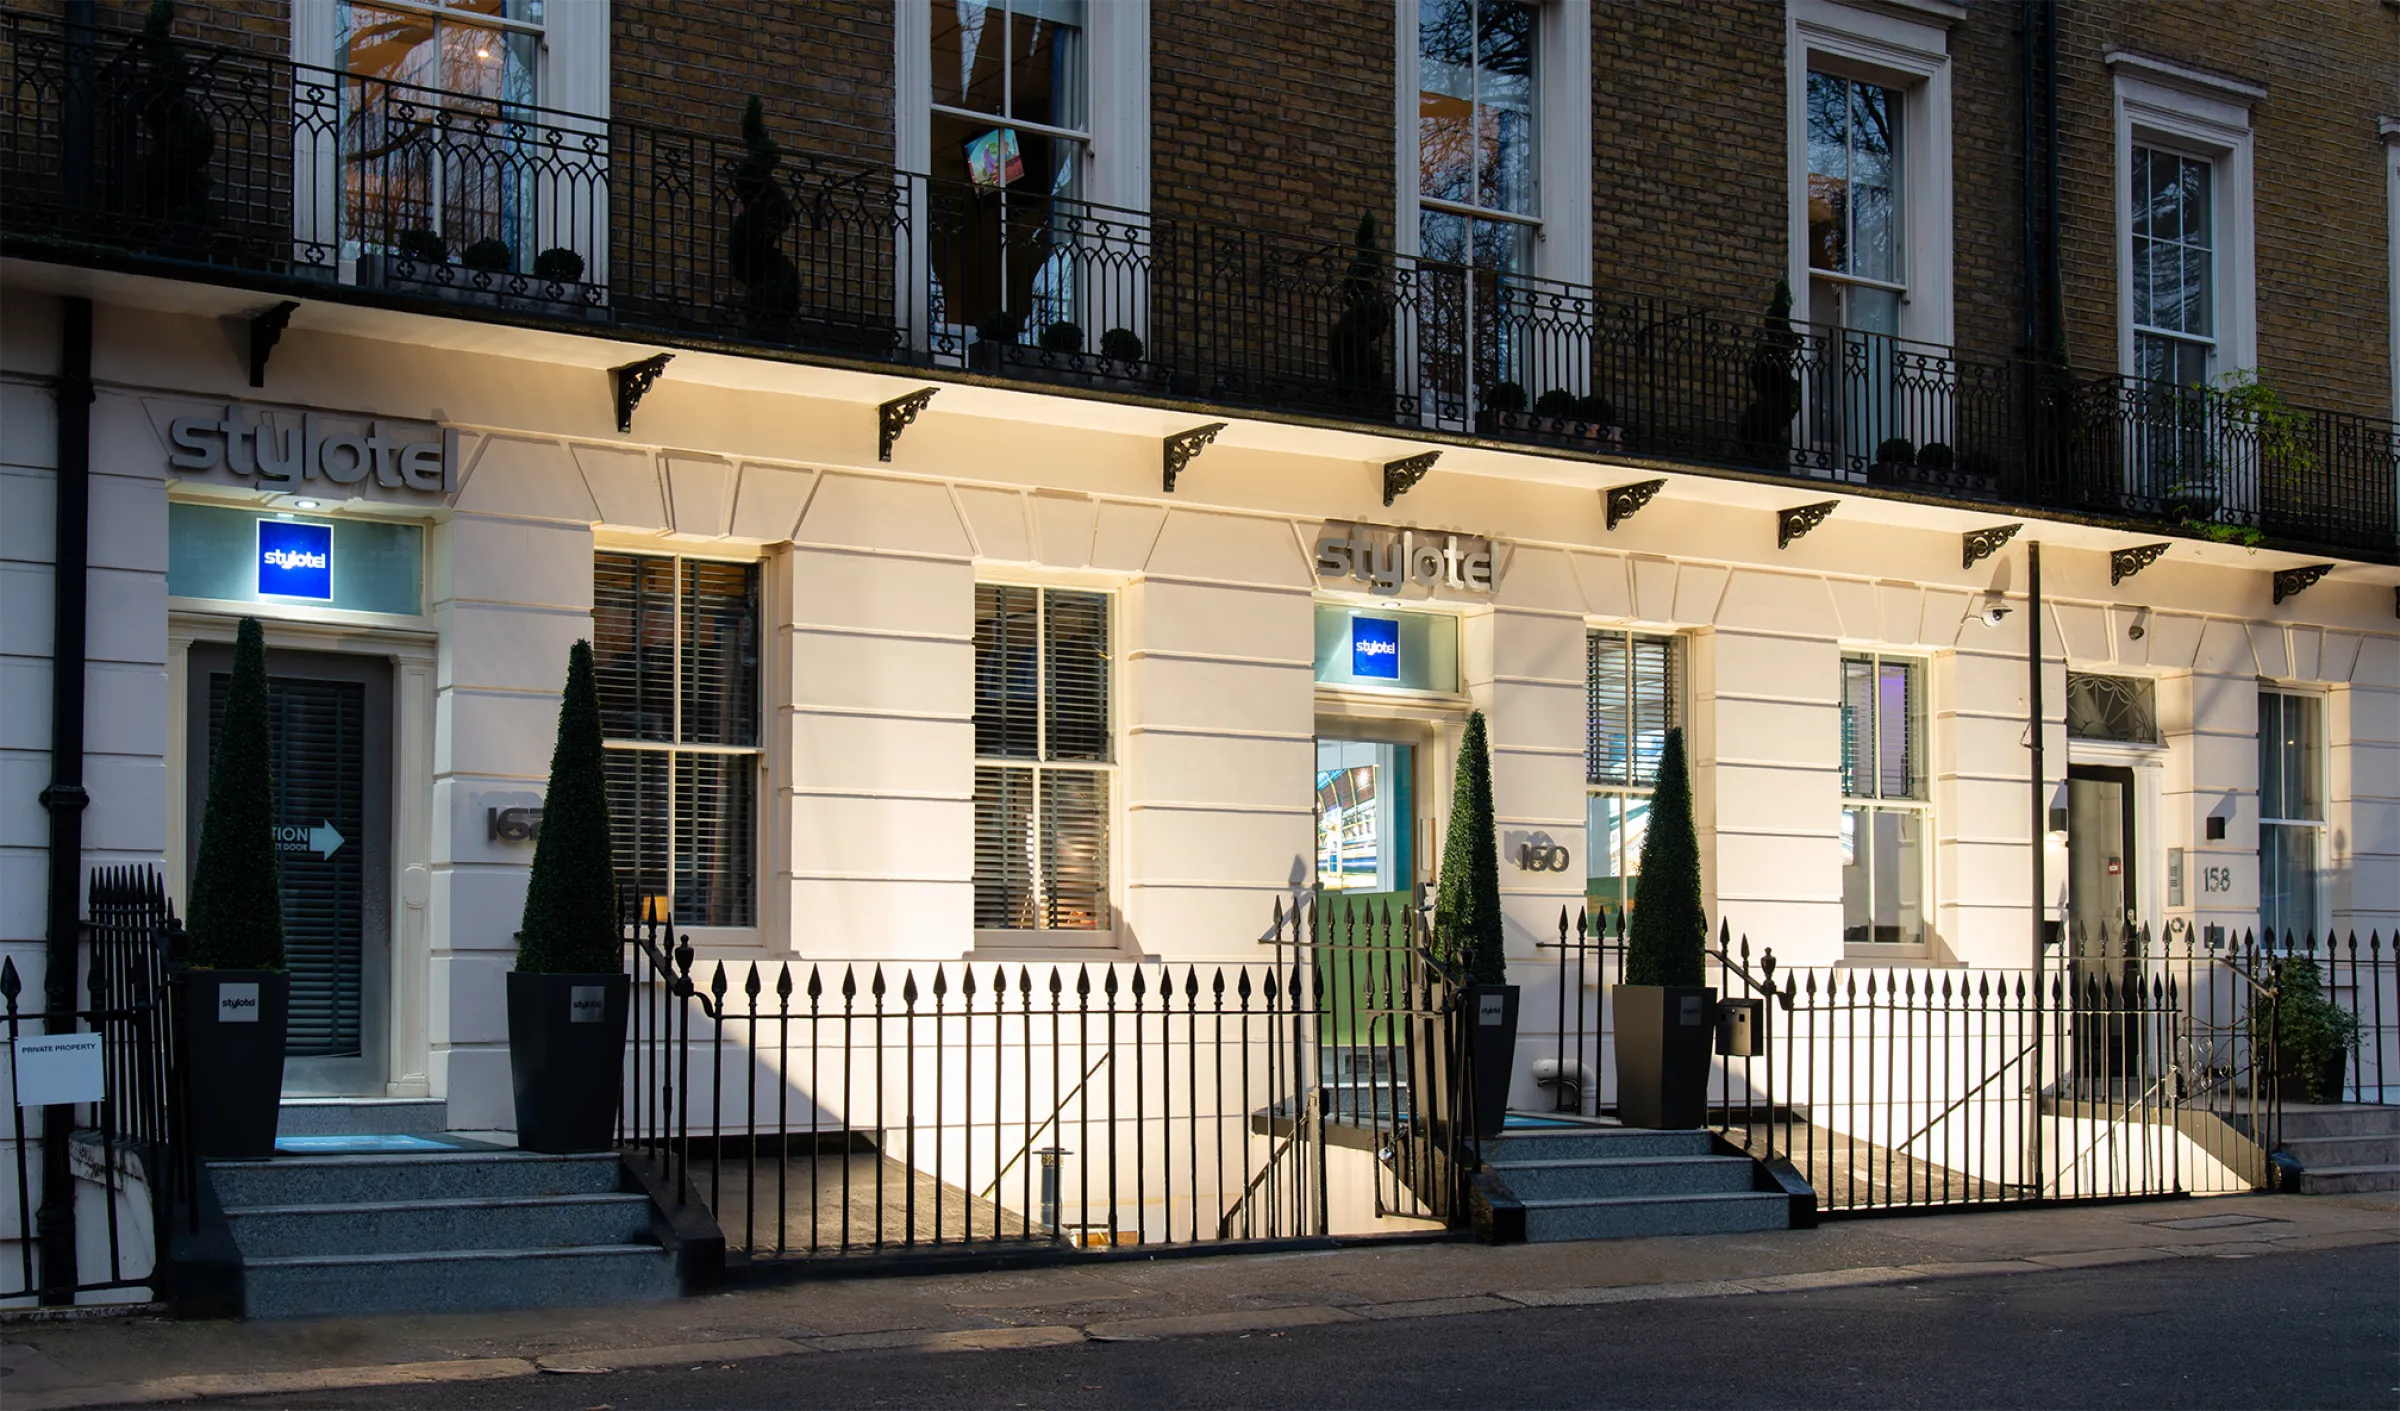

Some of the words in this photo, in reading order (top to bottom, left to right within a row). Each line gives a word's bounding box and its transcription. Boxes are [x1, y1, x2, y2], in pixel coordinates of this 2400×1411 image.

[169, 404, 458, 494] stylotel
[264, 549, 325, 569] stylotel
[1316, 526, 1501, 596] stylotel
[1355, 639, 1395, 656] stylotel
[283, 842, 308, 852] DOOR
[1520, 841, 1570, 873] 160
[2203, 865, 2231, 893] 158
[22, 1044, 53, 1053] PRIVATE
[55, 1043, 96, 1052] PROPERTY
